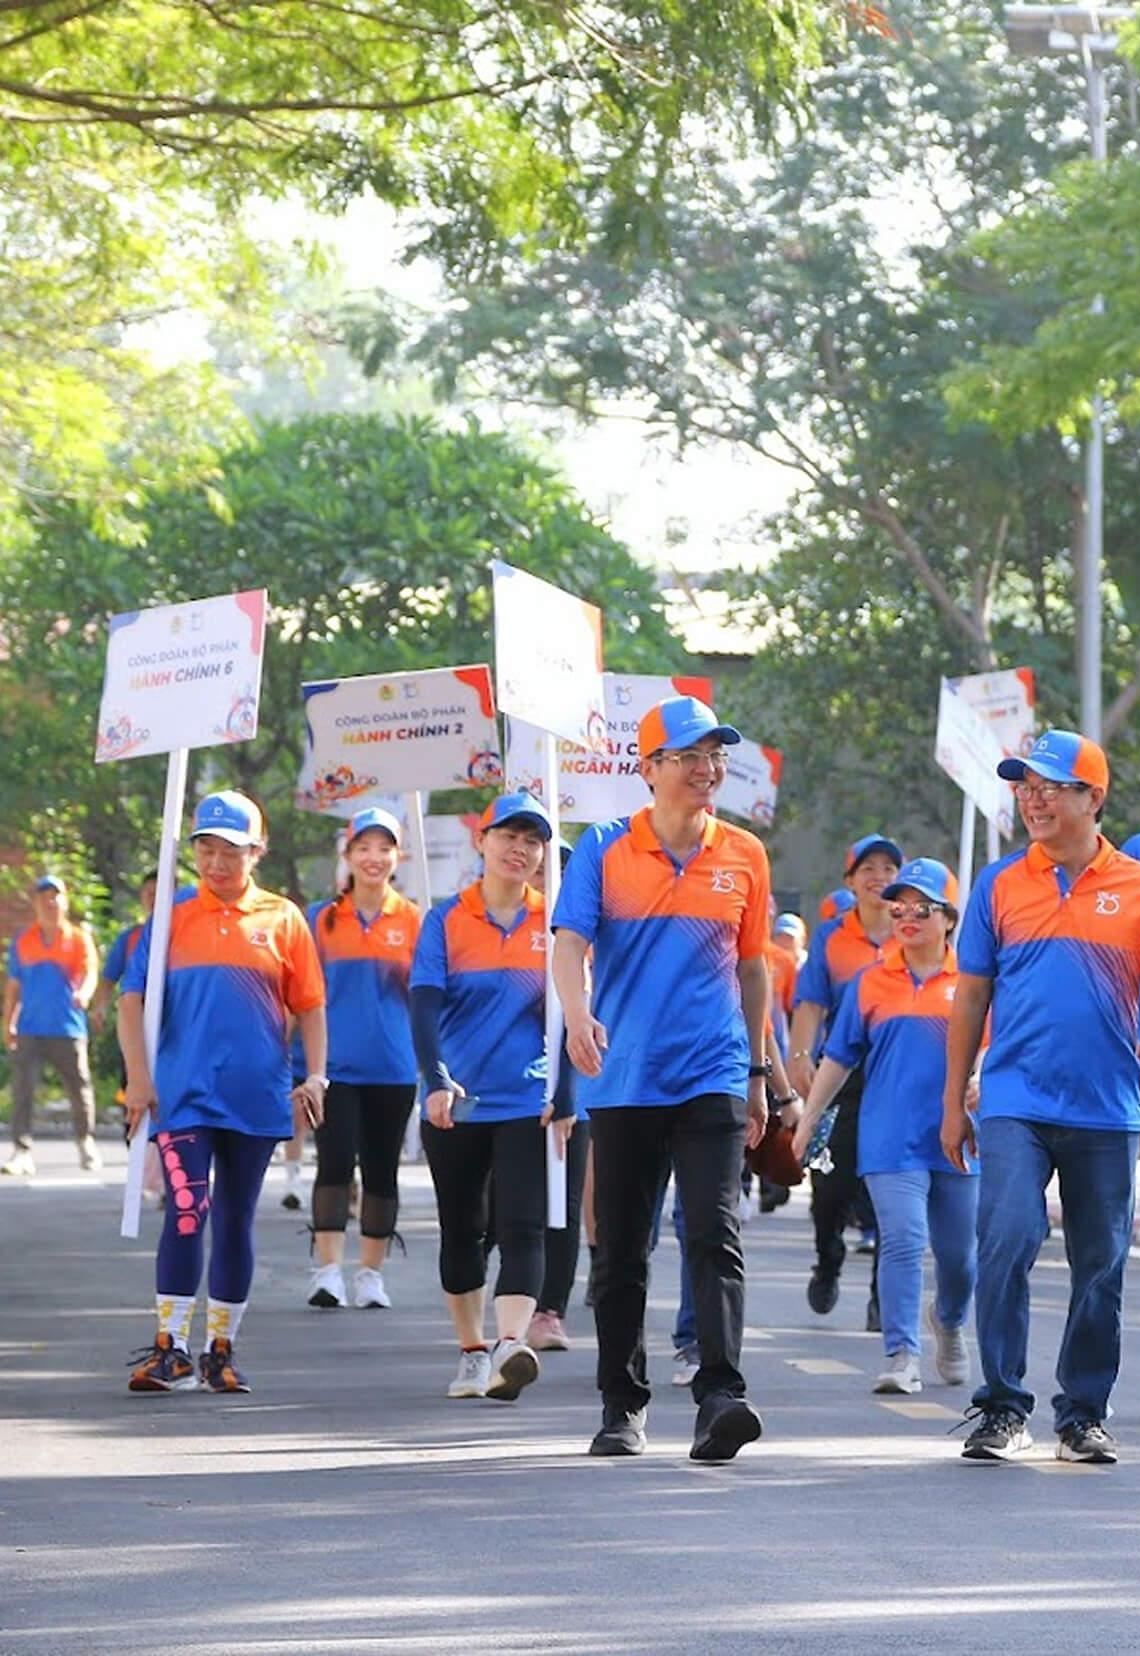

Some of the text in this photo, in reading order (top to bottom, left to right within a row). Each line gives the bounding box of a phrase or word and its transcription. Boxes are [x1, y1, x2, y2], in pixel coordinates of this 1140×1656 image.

[174, 662, 221, 682] CHÍNH
[224, 660, 234, 675] 6
[342, 722, 464, 744] HÀNH CHÍNH 2
[560, 756, 613, 775] NGÂN
